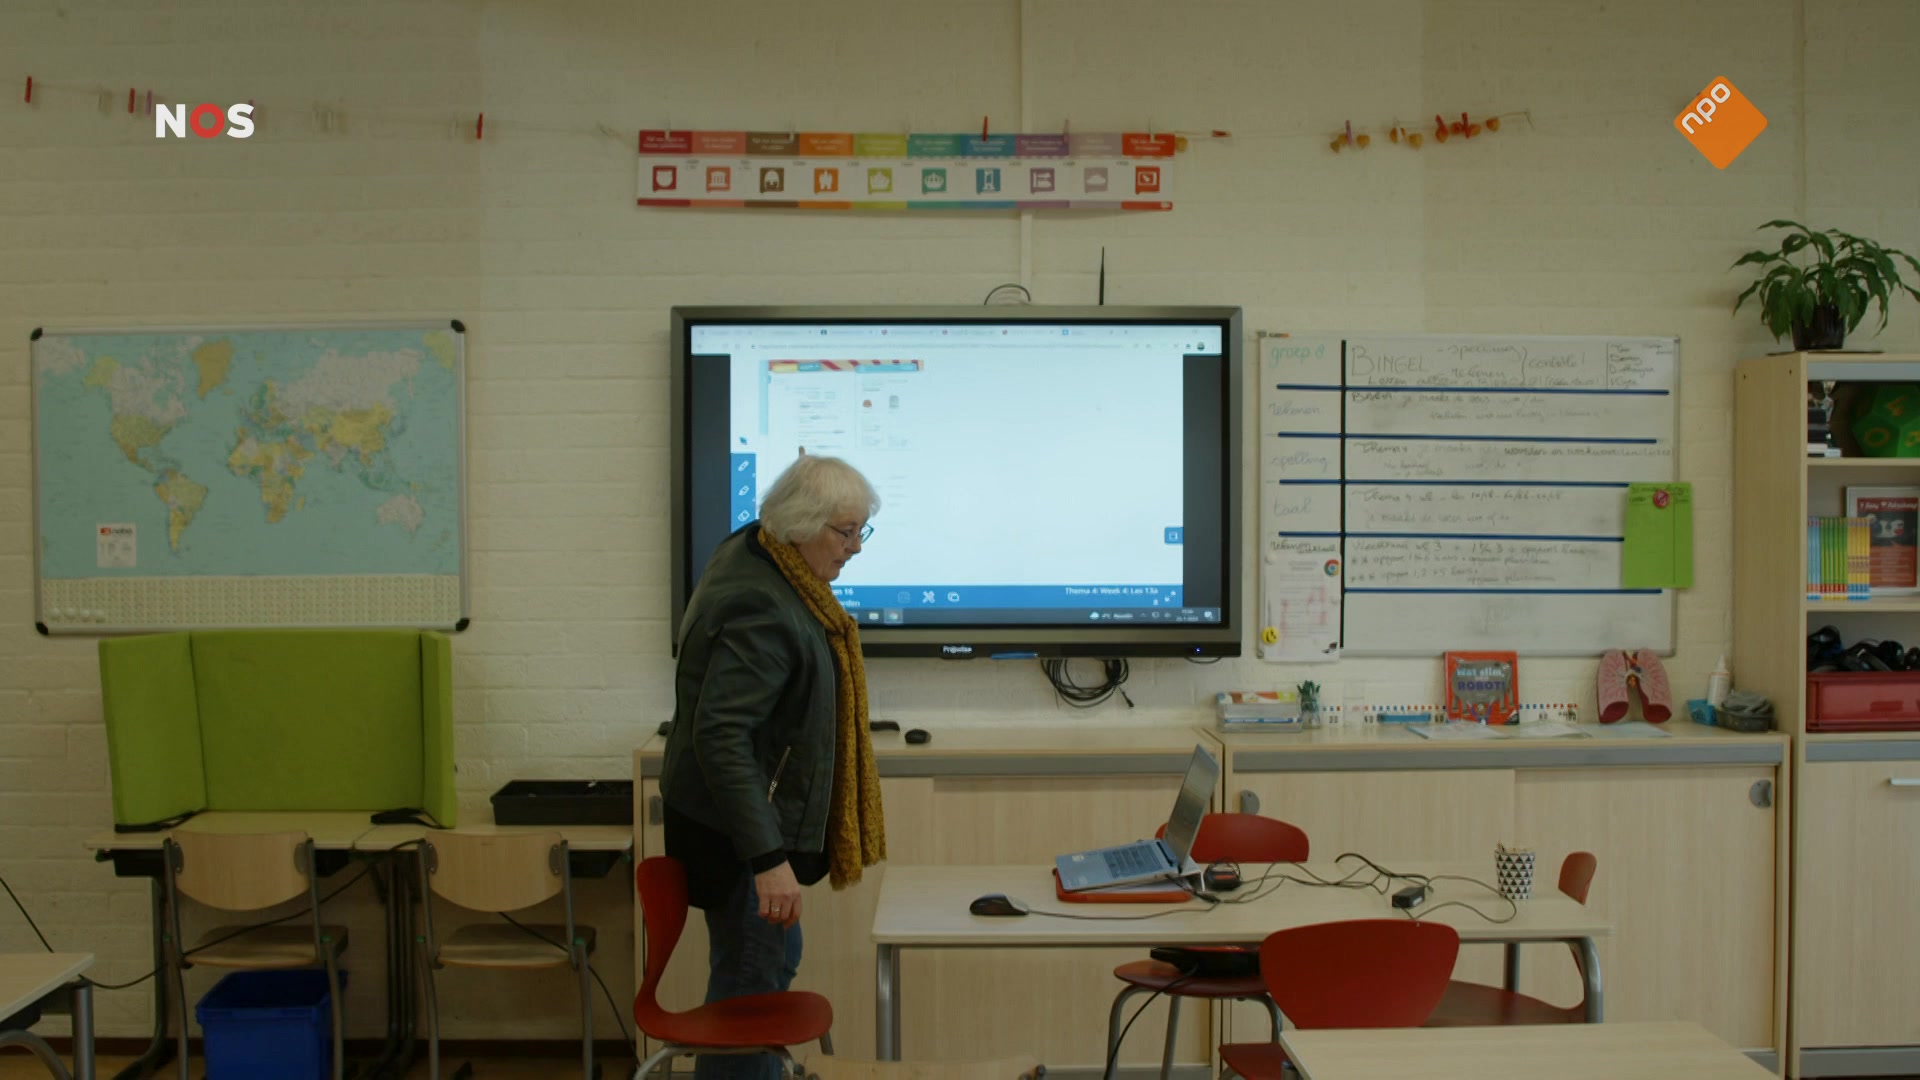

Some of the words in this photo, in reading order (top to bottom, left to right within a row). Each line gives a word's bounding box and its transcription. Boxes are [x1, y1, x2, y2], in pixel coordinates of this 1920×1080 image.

[1270, 345, 1311, 368] groep
[1351, 345, 1429, 377] BINGEL
[1458, 681, 1505, 690] ROBOT!
